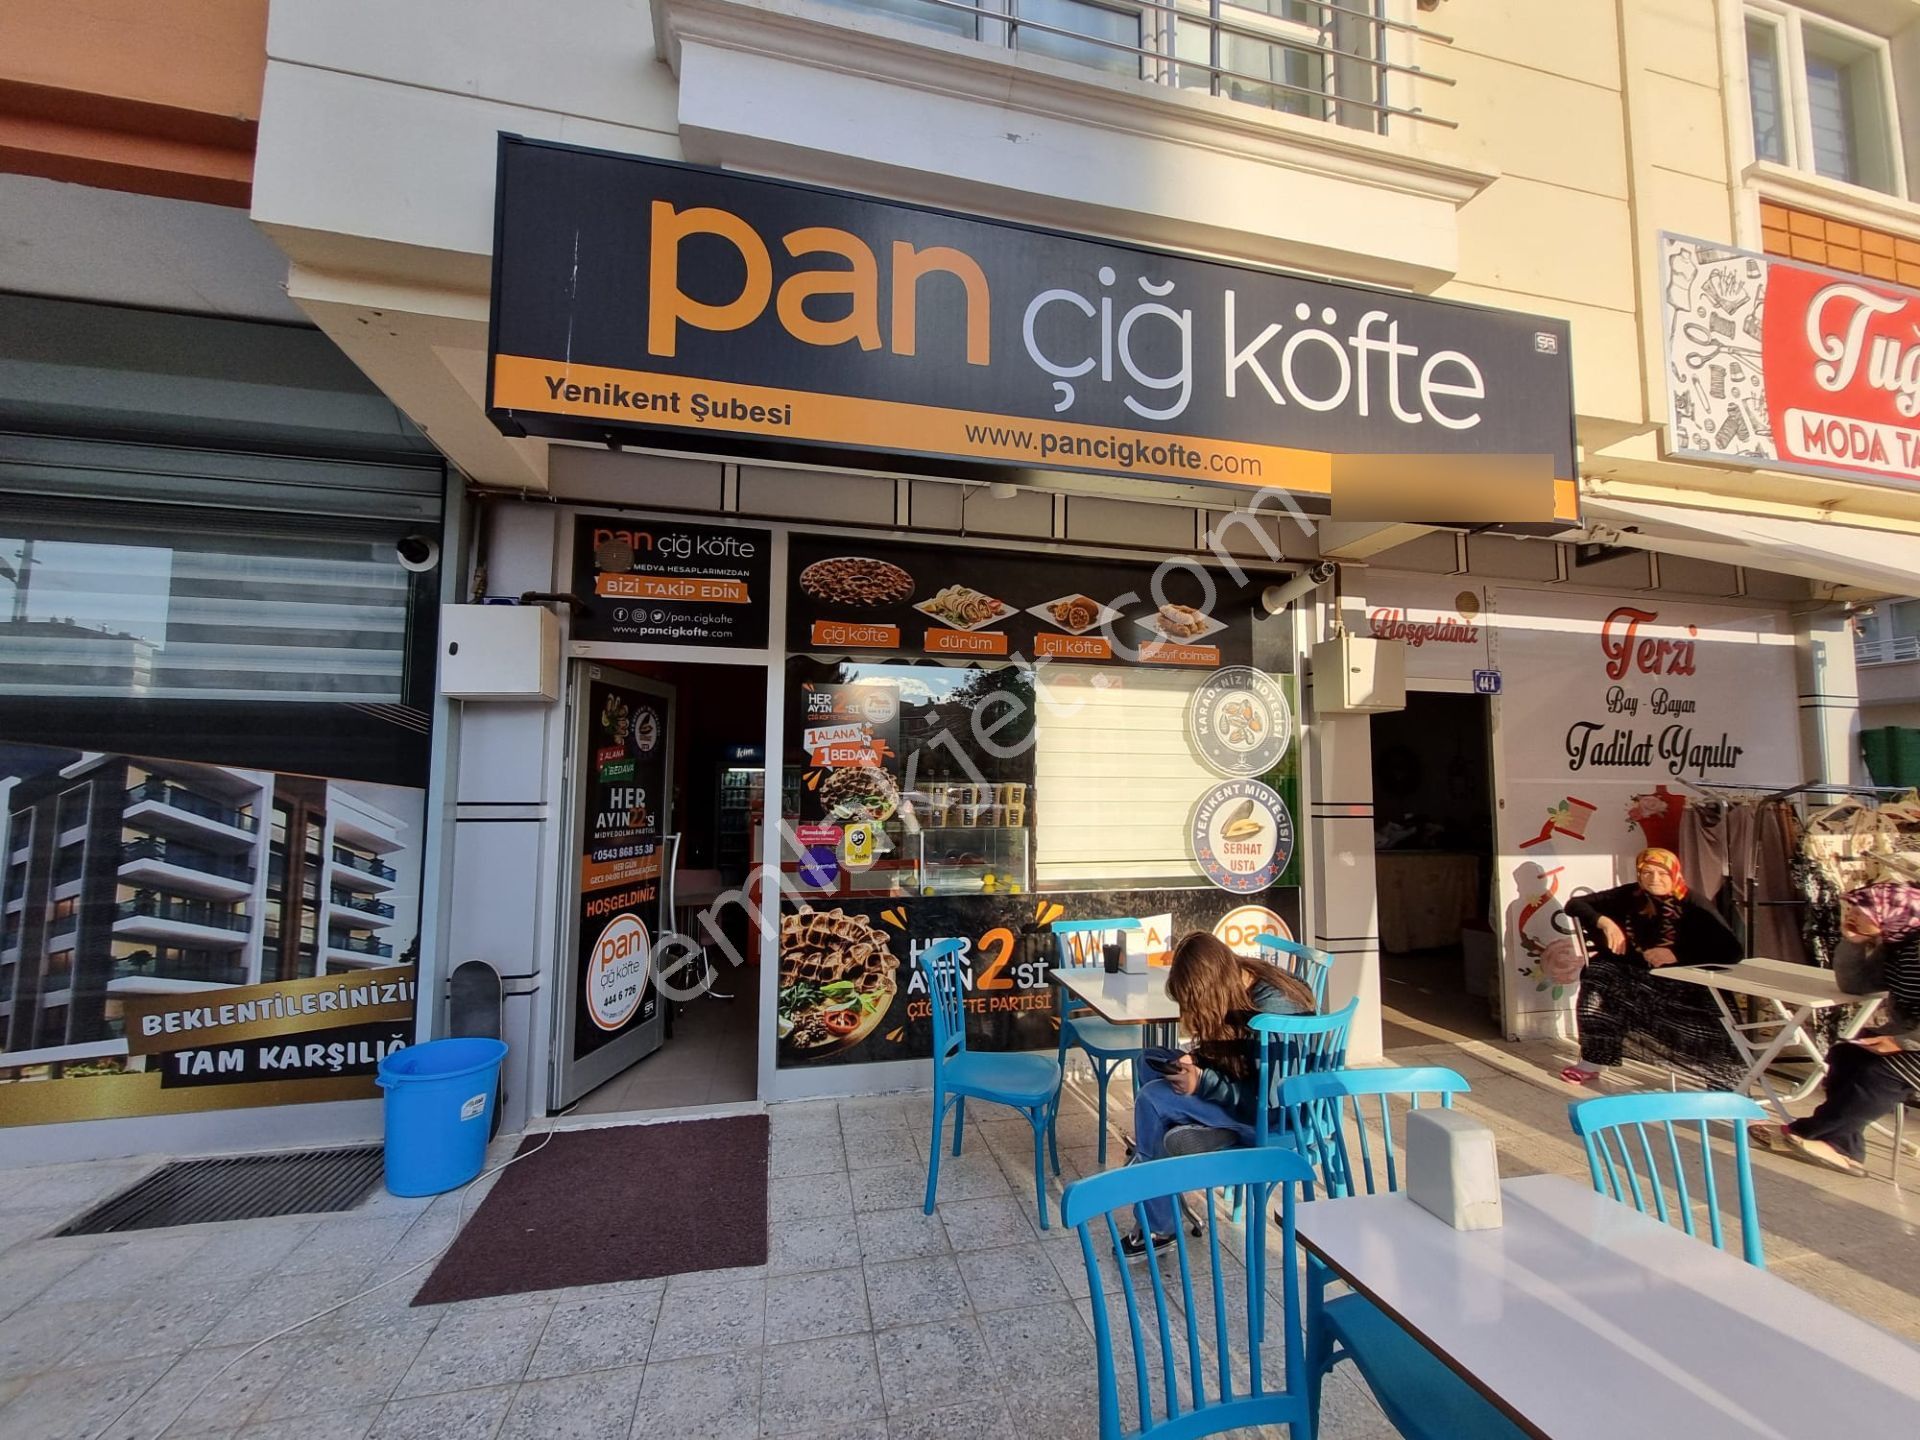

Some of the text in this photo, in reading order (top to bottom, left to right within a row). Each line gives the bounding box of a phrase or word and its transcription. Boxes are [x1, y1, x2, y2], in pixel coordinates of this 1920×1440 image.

[647, 199, 1486, 430] pan çiğ köfte
[545, 375, 792, 426] Yenikent Şubesi
[965, 424, 1261, 477] www.pancigkofte.com
[1801, 415, 1890, 466] MODA
[594, 528, 755, 558] pan çiğ köfte
[633, 563, 665, 571] MEDYA
[667, 566, 750, 577] HESAPLARIMIZDAN
[606, 576, 740, 599] BİZİ TAKİP EDİN
[612, 626, 733, 638] www.pancigkofte.com
[822, 625, 889, 644] çiğ köfte
[1370, 608, 1479, 647] Hoşgeldiniz
[939, 632, 993, 650] dürüm
[1043, 638, 1103, 655] içli köfte
[1601, 607, 1696, 680] Terzi
[807, 704, 832, 713] AYIN
[808, 693, 832, 705] HER
[1199, 674, 1284, 739] KARADENİZ MİDYECİSİ
[1606, 685, 1638, 716] Bay
[1650, 687, 1696, 718] Bayan
[808, 728, 855, 744] 1 ALANA
[820, 748, 878, 765] 1 BEDAVA
[1566, 721, 1744, 778] Tadilat Yapılır
[608, 764, 635, 776] BEDAVA
[610, 787, 646, 809] HER
[596, 811, 631, 829] AYIN
[1196, 784, 1291, 842] YENİKENT MİDYECİSİ
[597, 844, 654, 860] 0543 868 55 38
[1223, 842, 1263, 855] SERHAT
[1230, 859, 1256, 872] USTA
[586, 886, 656, 917] HOŞGELDİNİZ
[600, 929, 641, 972] pan
[600, 960, 640, 990] çiğ köfte
[604, 984, 637, 1007] 444 6 726
[990, 993, 1052, 1012] PARTİSİ
[175, 1048, 245, 1076] TAM
